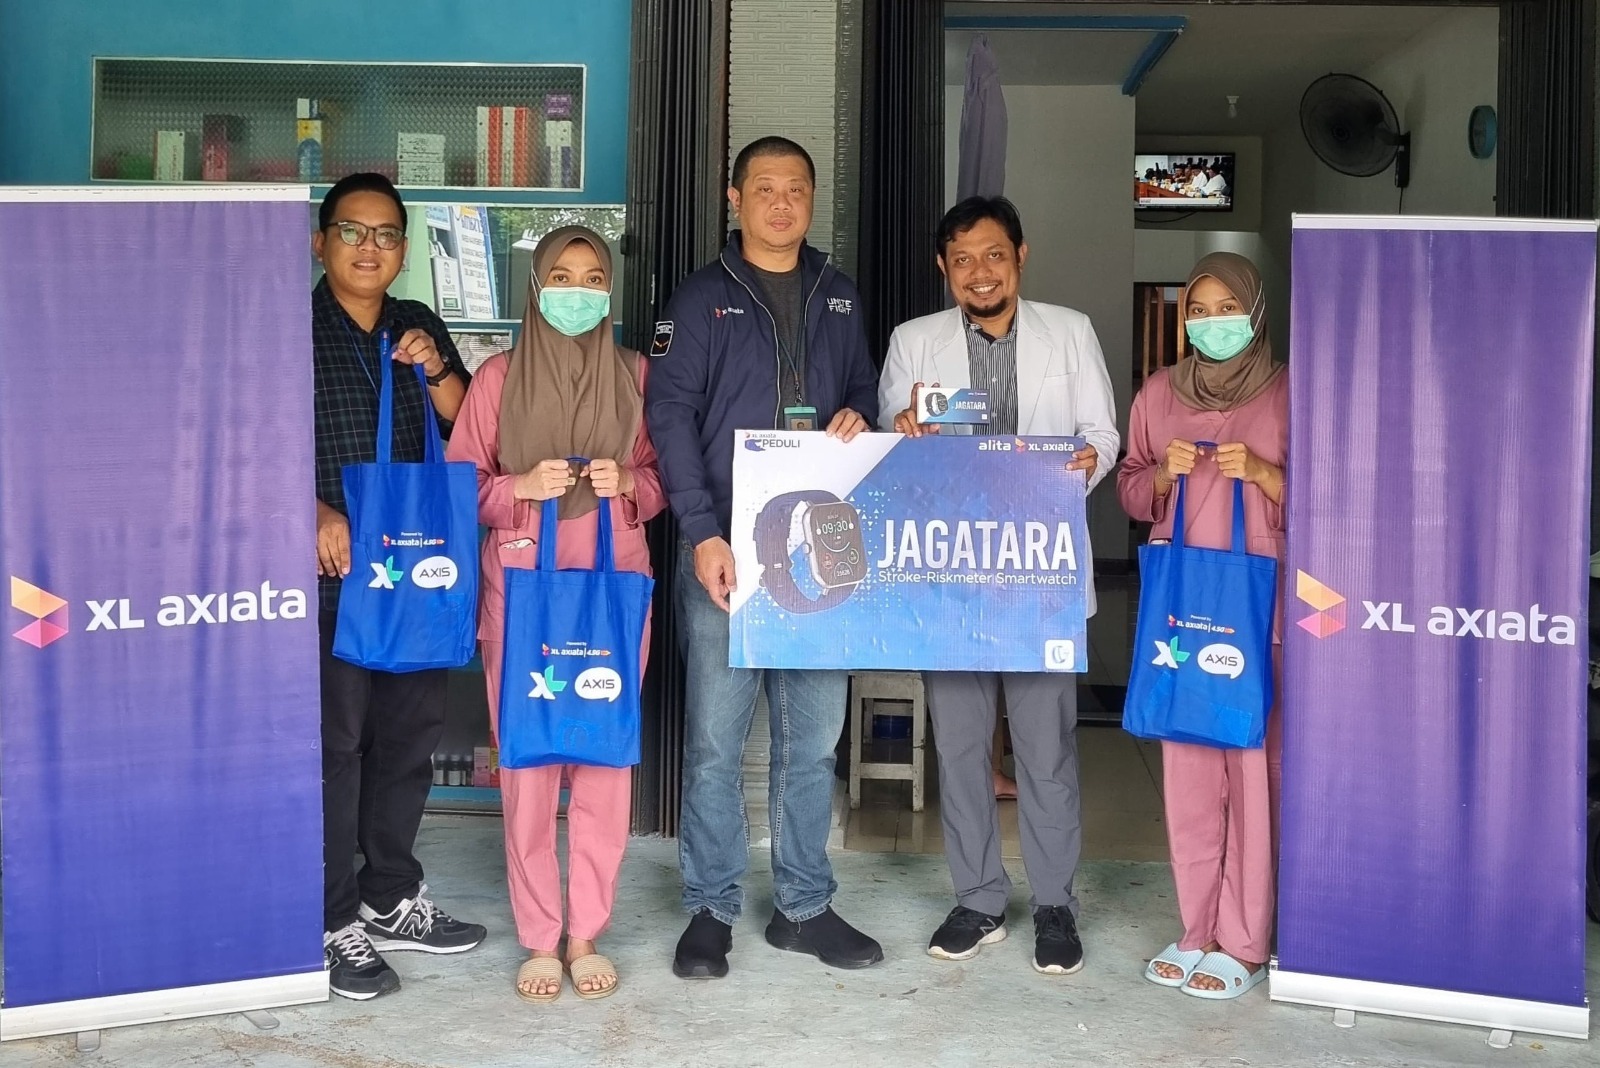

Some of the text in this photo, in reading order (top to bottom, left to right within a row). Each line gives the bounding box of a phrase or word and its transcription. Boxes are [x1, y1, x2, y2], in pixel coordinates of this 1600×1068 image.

[954, 401, 987, 410] JAGATARA
[762, 439, 801, 448] PEDULI
[978, 439, 1012, 451] alita
[1028, 441, 1075, 452] XL axiata
[821, 520, 848, 535] 09:30
[397, 538, 420, 546] axiata
[877, 519, 1078, 571] JAGATARA
[419, 566, 451, 578] AXIS
[877, 570, 1078, 585] Stroke-Riskmeter Smartwatch
[84, 579, 308, 632] XL axiata
[1185, 621, 1208, 631] axiata
[1361, 600, 1577, 646] XL axiata
[560, 648, 584, 656] axiata
[1204, 653, 1238, 667] AXIS
[581, 679, 615, 689] AXIS
